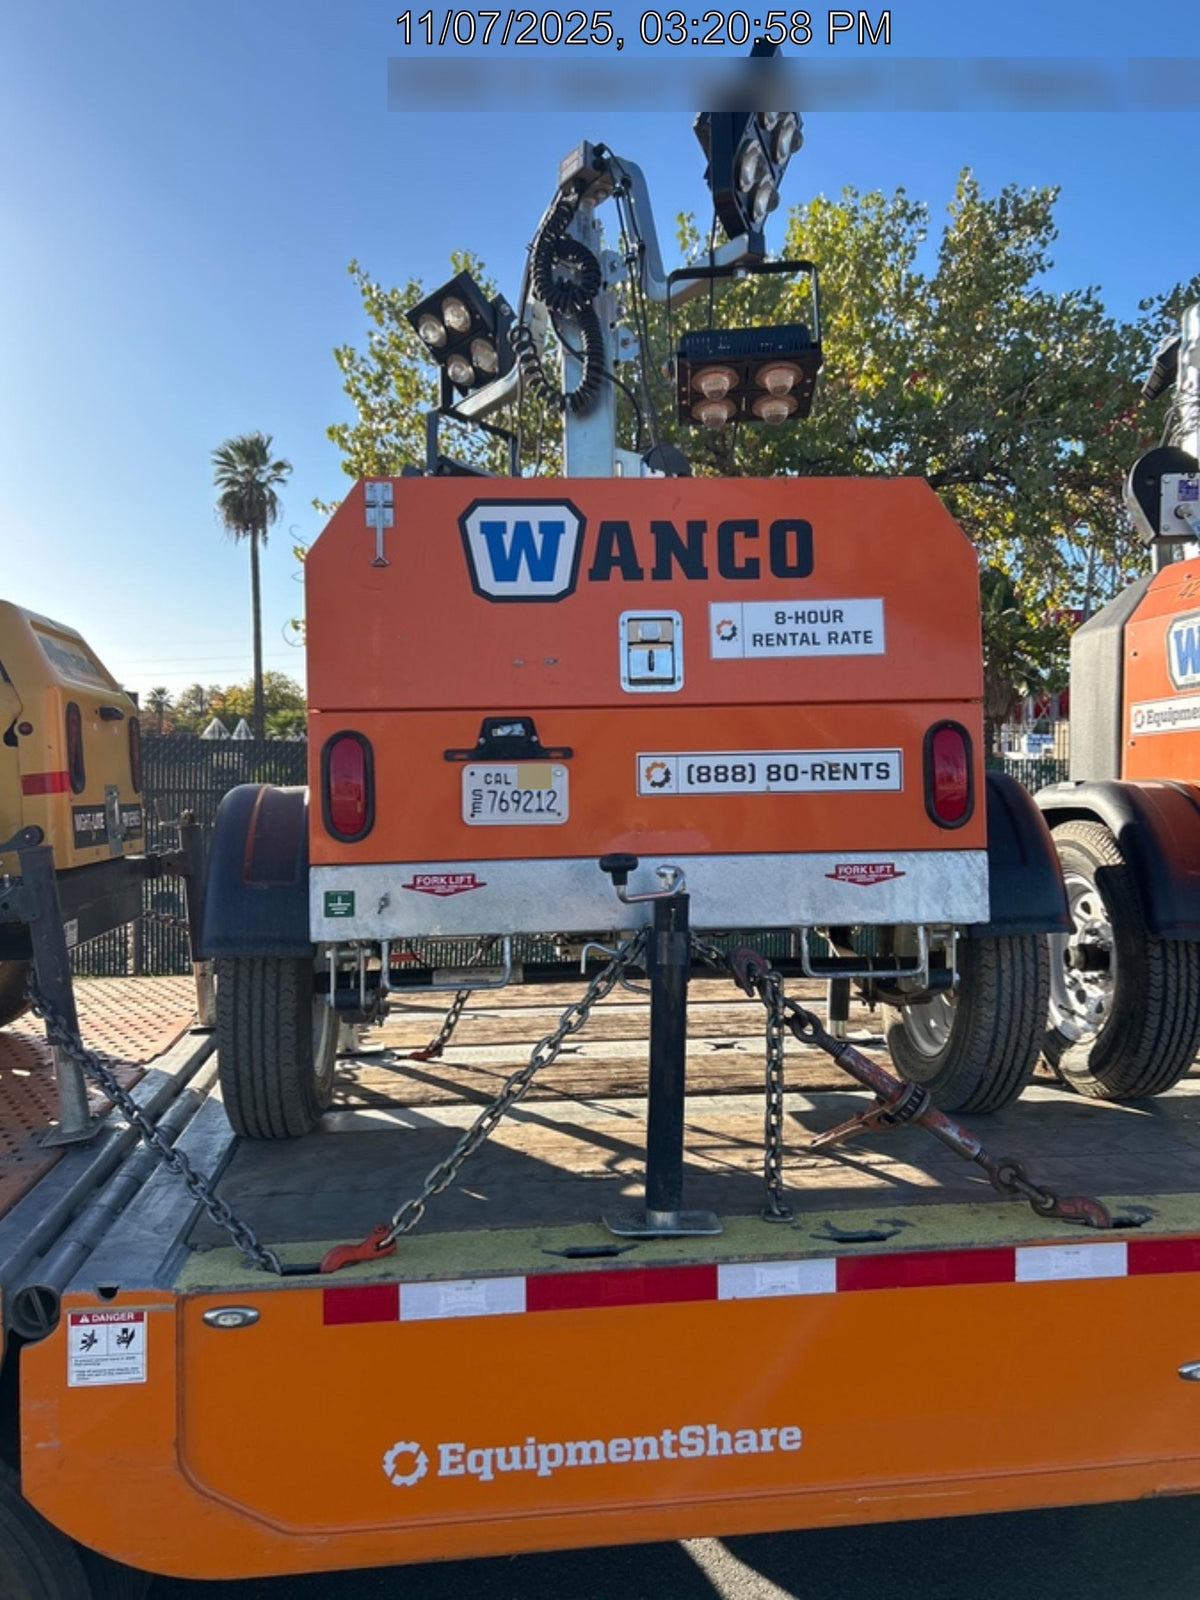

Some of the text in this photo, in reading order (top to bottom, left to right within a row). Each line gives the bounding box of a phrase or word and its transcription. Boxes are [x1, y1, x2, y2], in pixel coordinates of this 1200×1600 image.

[480, 518, 814, 582] WANCO
[774, 609, 844, 625] 8-HOUR
[752, 629, 873, 648] RENTAL RATE
[483, 772, 512, 785] CAL
[686, 761, 891, 785] (888) 80-RENTS
[486, 789, 558, 813] 769212
[868, 865, 892, 874] LIFT
[415, 874, 474, 885] FORK LIFT
[91, 1312, 135, 1323] DANGER
[437, 1424, 802, 1481] EquipmentShare
